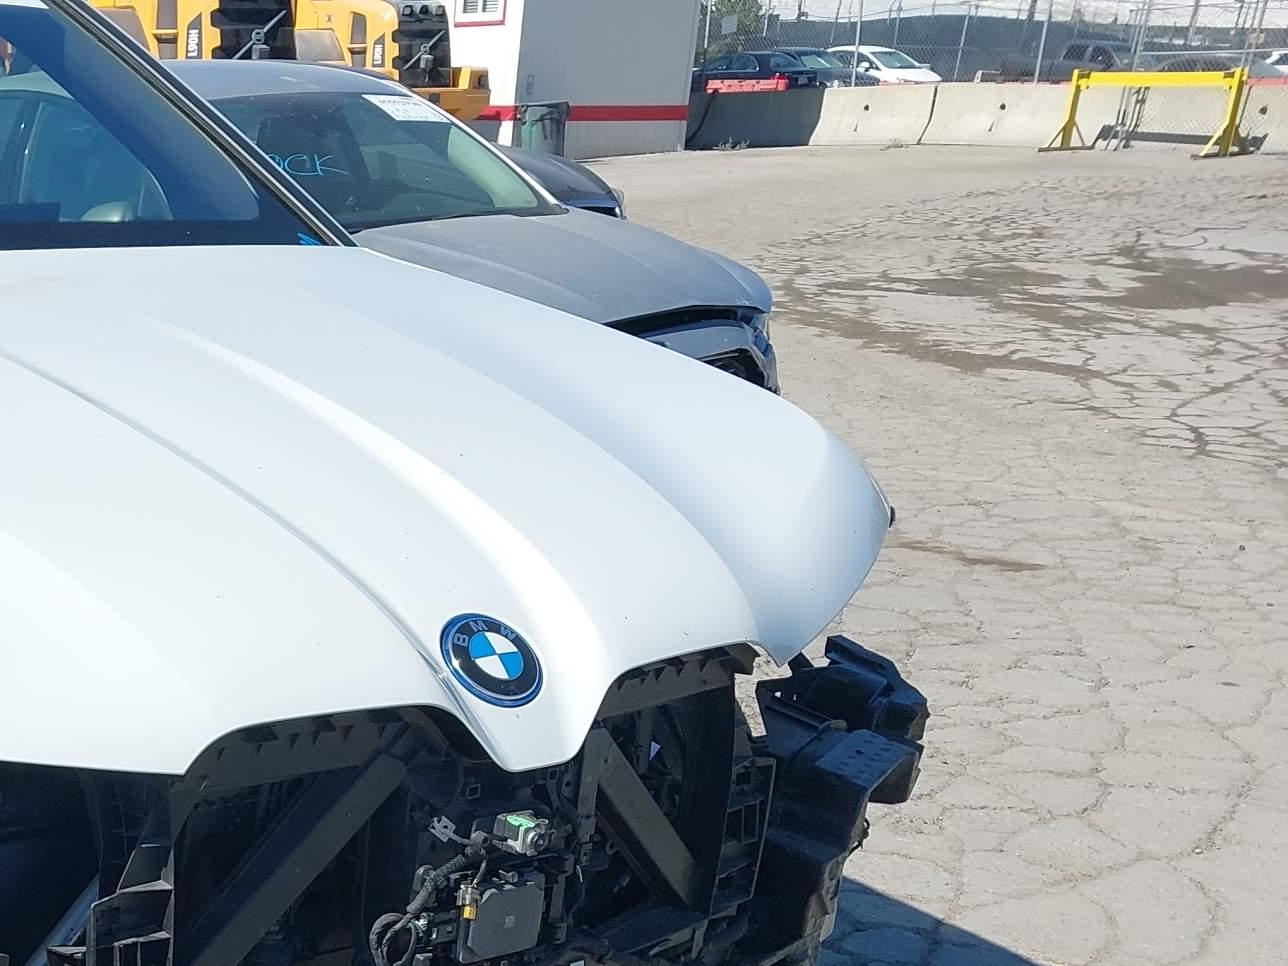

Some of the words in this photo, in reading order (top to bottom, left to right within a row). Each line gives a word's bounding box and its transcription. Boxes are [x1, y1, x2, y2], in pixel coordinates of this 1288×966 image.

[187, 29, 199, 57] L90H
[373, 44, 383, 65] L90H
[453, 620, 517, 647] BMW
